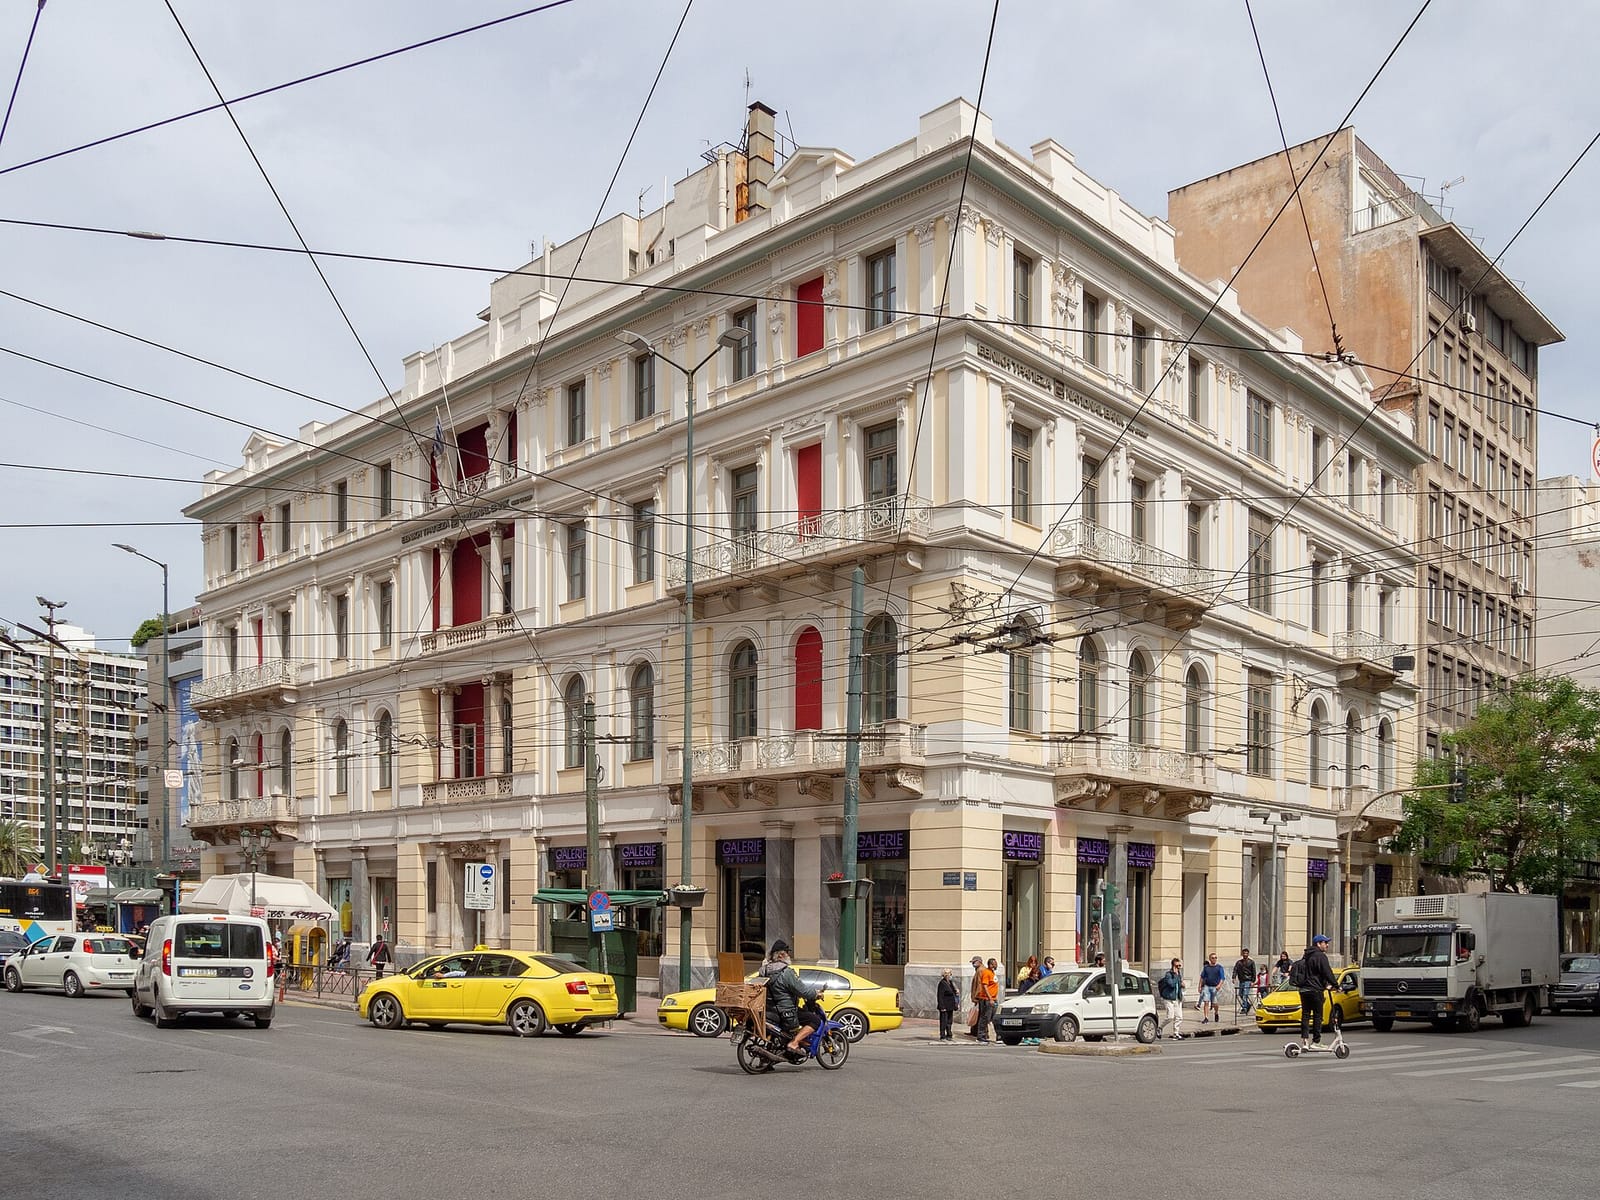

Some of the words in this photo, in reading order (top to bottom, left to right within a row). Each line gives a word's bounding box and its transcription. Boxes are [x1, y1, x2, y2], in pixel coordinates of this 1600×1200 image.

[723, 840, 762, 854] GALERIE
[857, 833, 903, 848] GALERIE
[1005, 832, 1041, 849] GALERIE
[1078, 839, 1109, 855] GALERIE
[555, 848, 587, 860] GALERIE
[622, 845, 657, 857] GALERIE
